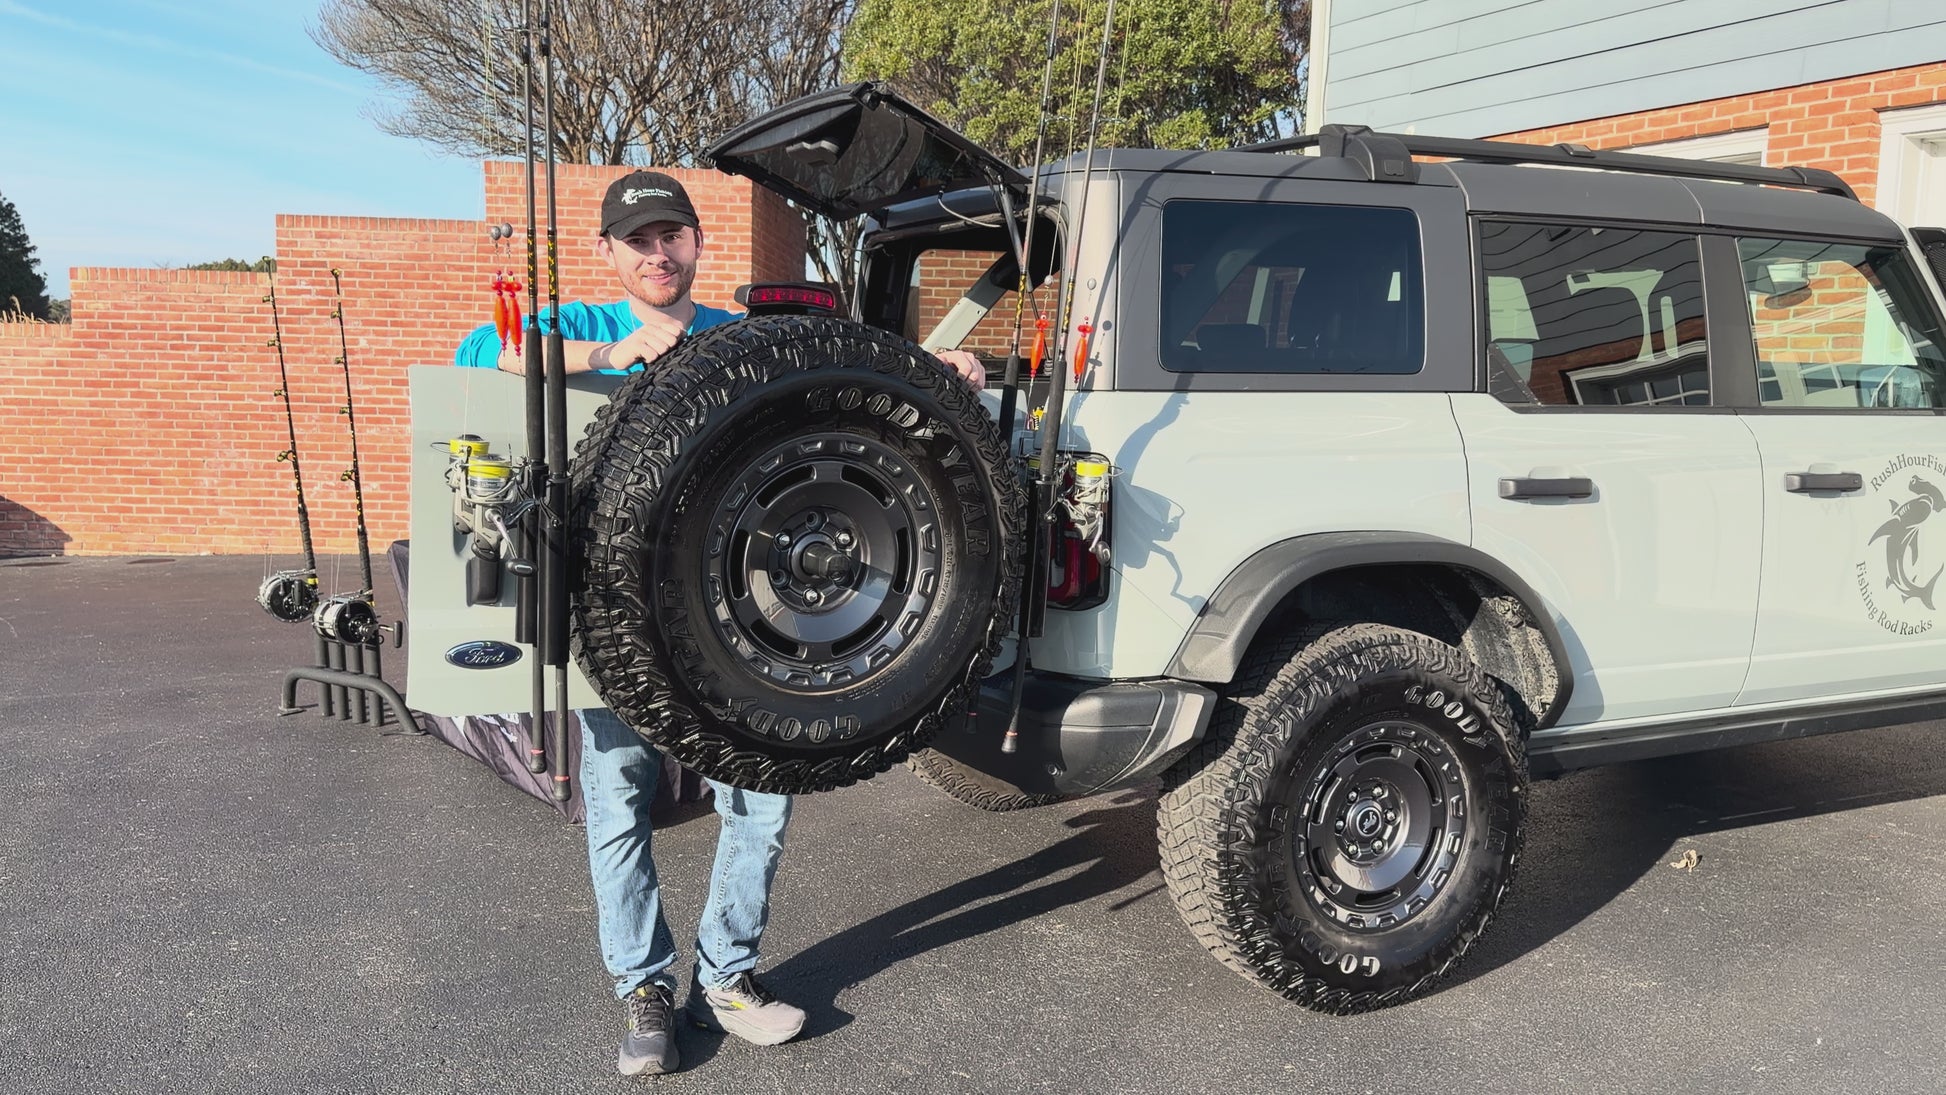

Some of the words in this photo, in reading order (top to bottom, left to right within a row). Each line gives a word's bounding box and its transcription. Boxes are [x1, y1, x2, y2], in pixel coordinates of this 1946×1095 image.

[1856, 561, 1878, 619] Fishing
[1876, 610, 1899, 635] Rod
[1899, 619, 1933, 636] Racks
[464, 647, 505, 664] Ford
